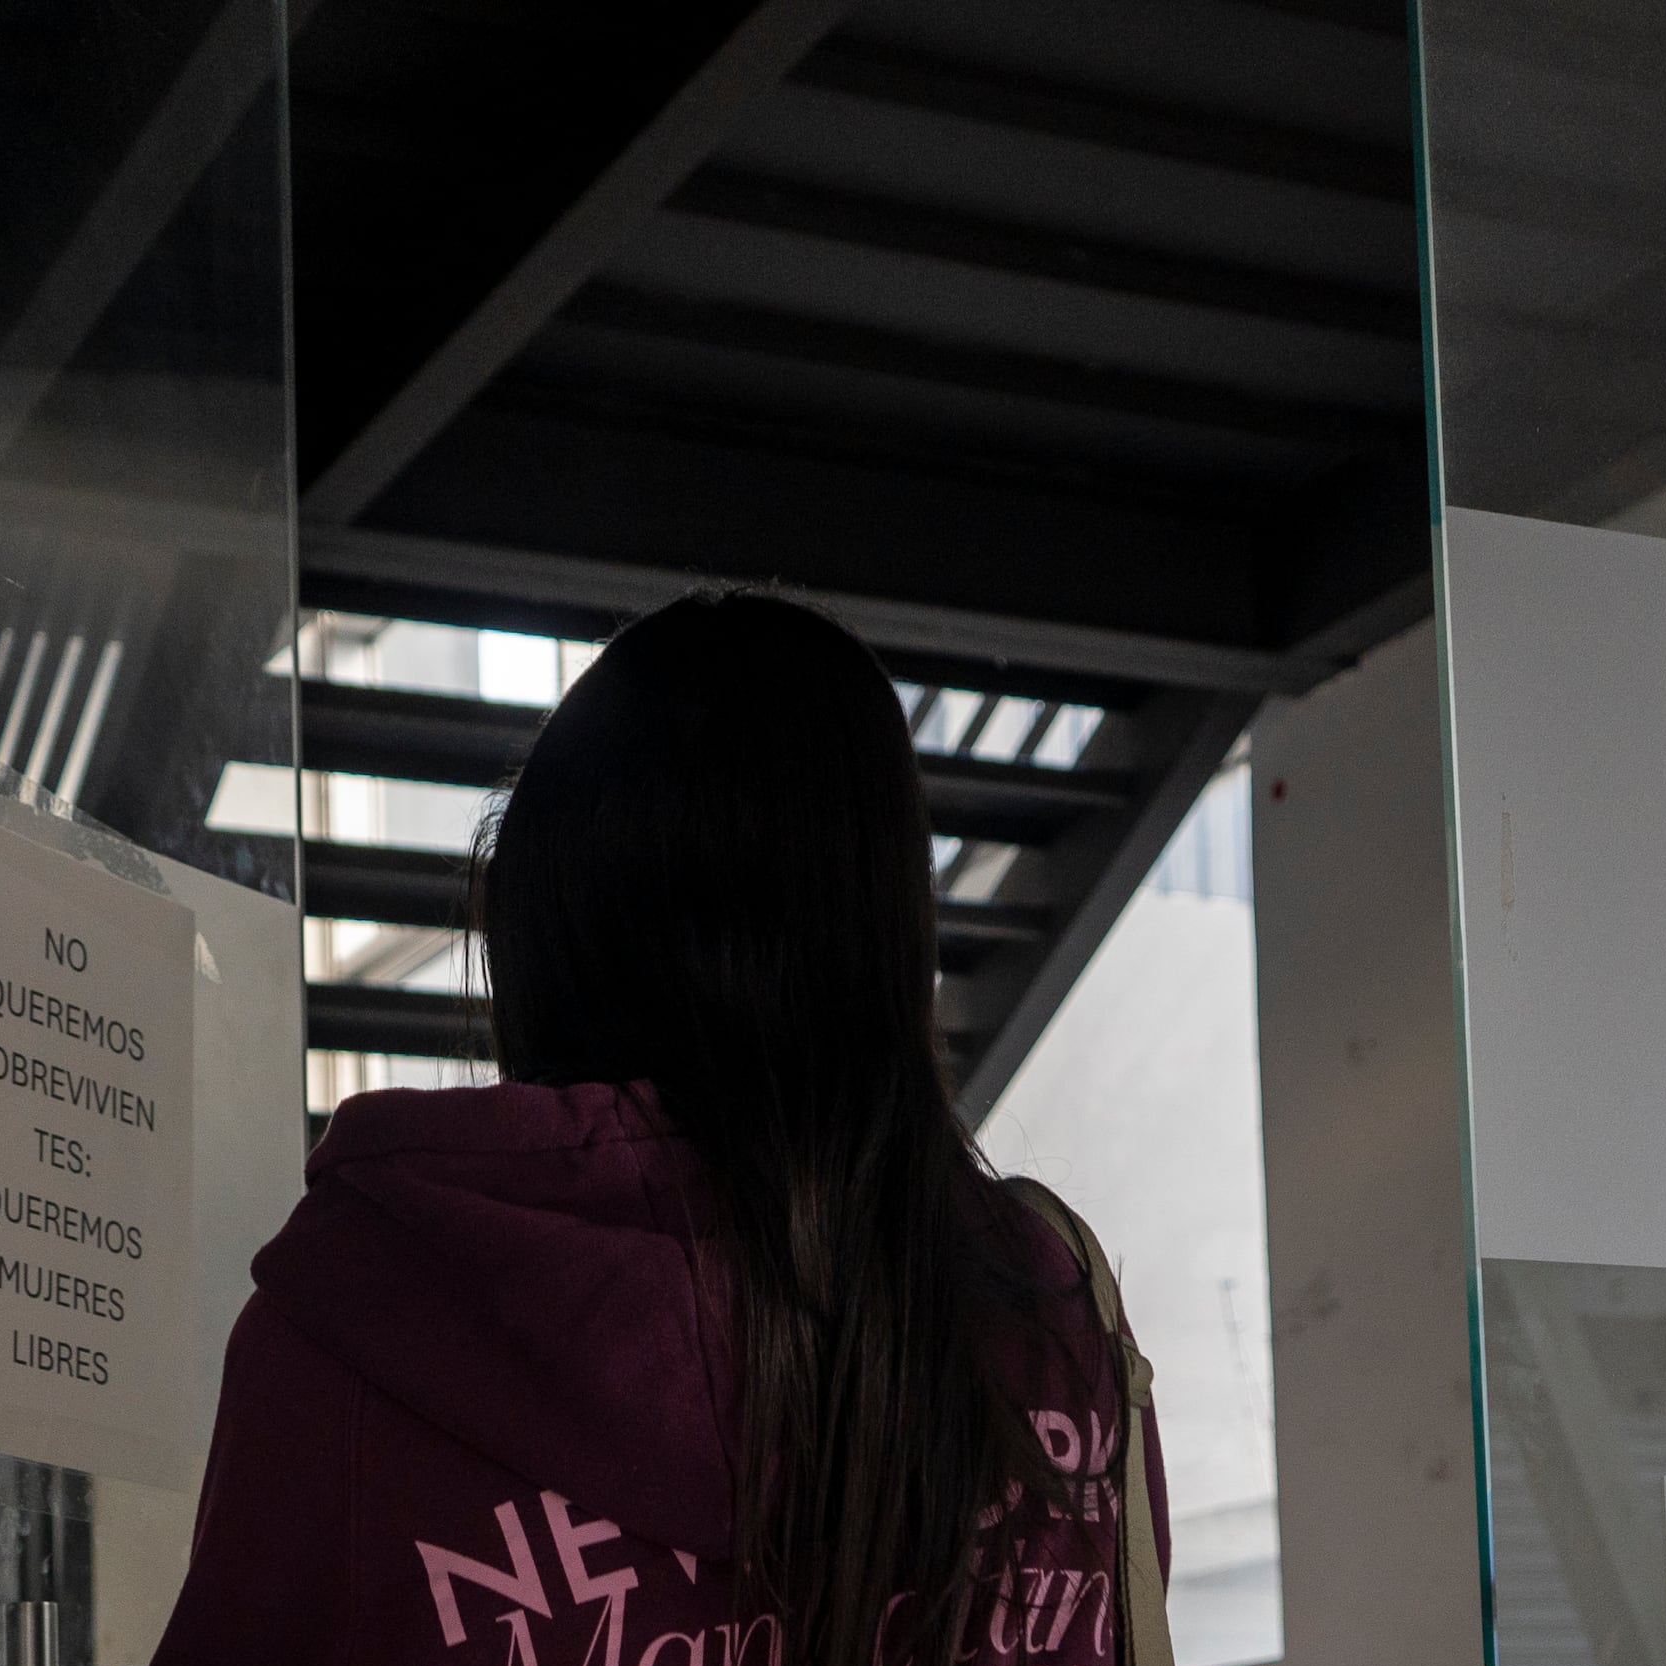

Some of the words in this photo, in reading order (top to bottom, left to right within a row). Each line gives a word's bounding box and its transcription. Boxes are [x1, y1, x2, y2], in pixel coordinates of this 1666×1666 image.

[44, 927, 87, 973] NO
[33, 1127, 91, 1178] TES:
[12, 1329, 108, 1386] LIBRES
